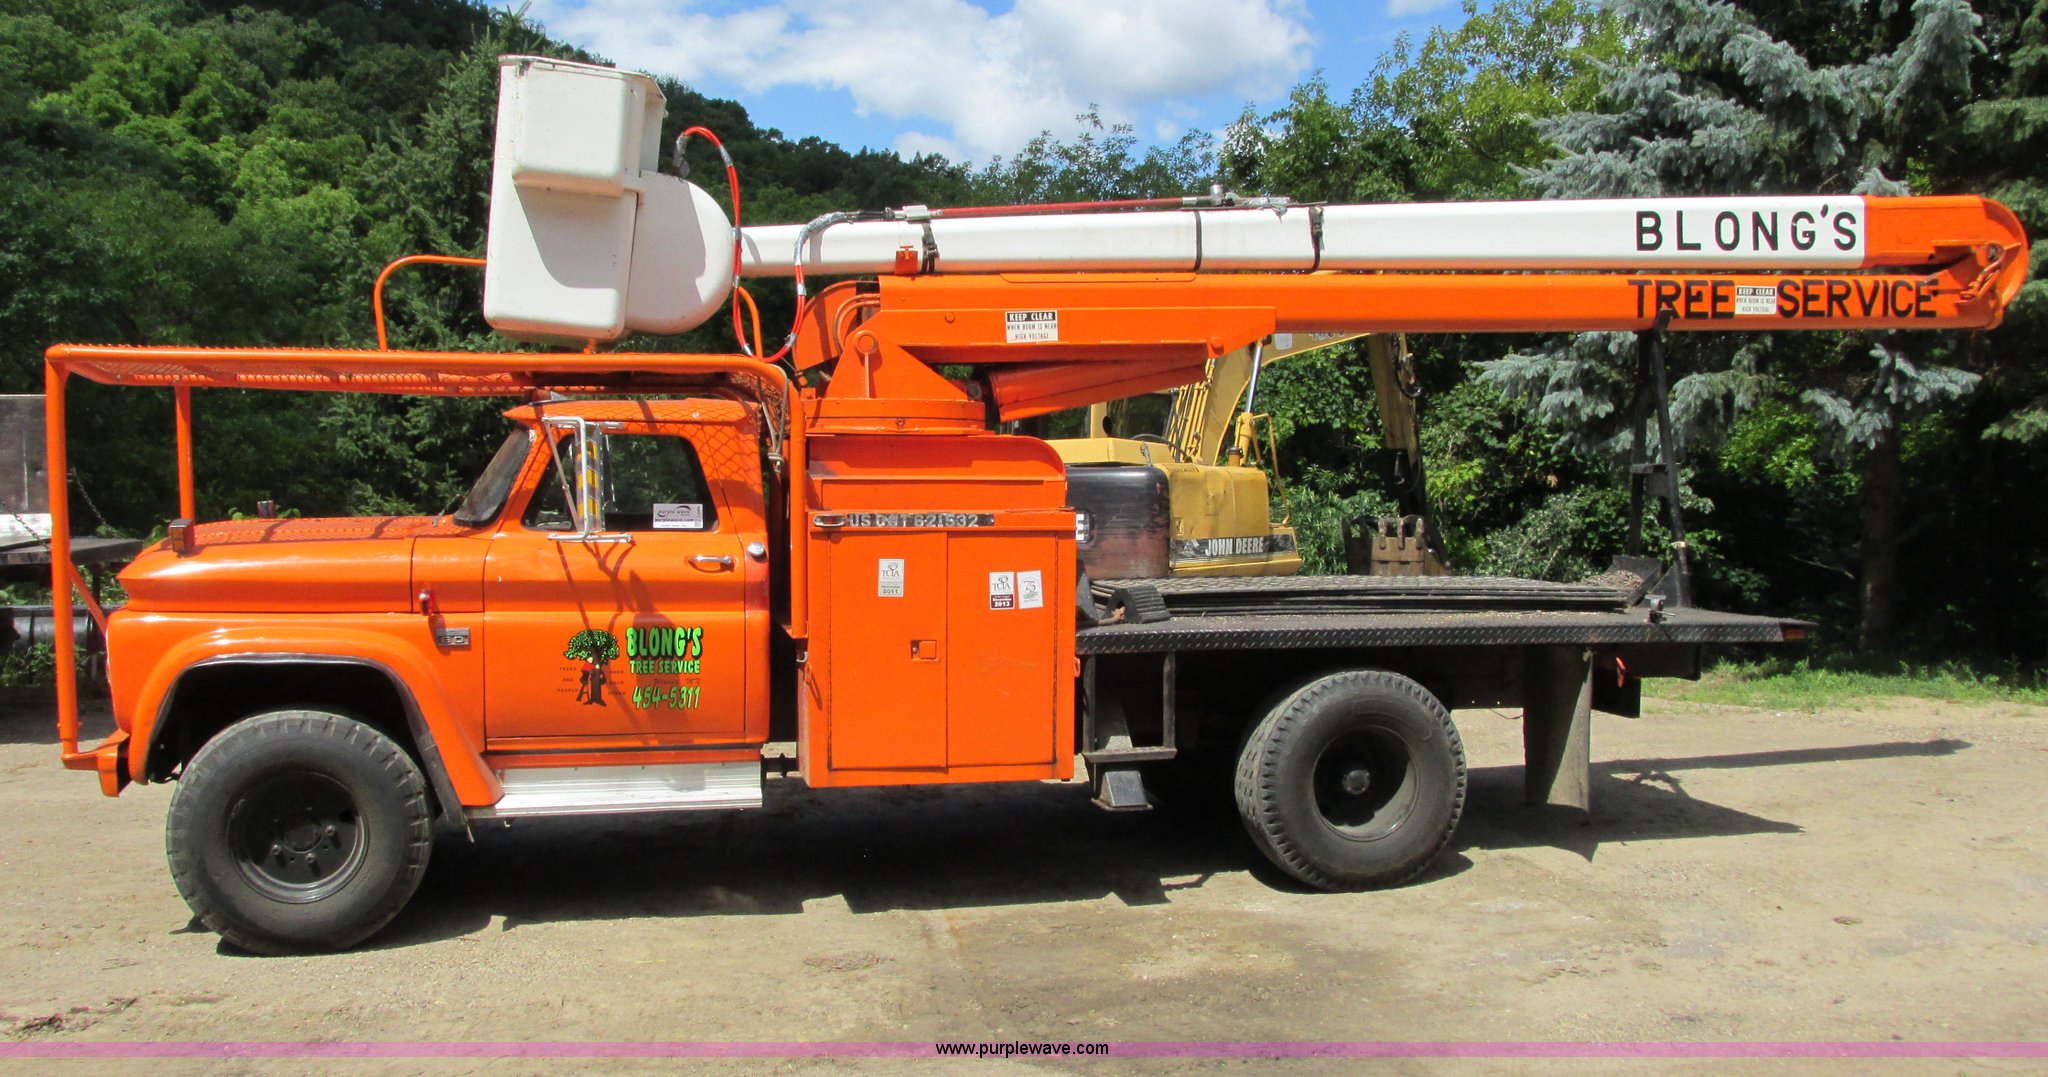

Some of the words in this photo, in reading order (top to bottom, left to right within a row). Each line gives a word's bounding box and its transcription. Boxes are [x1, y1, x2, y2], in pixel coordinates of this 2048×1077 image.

[1636, 204, 1857, 251] BLONG'S
[1627, 279, 1735, 320] TREE
[1776, 279, 1939, 319] SERVICE
[1009, 313, 1028, 321] KEEP
[1030, 312, 1053, 320] CLEAR
[1204, 539, 1234, 556] JOHN
[1235, 537, 1264, 553] DEERE
[626, 626, 703, 659] BLONG'S
[629, 660, 655, 674] TREE
[658, 660, 700, 674] SERVICE
[632, 686, 701, 710] 454-5311
